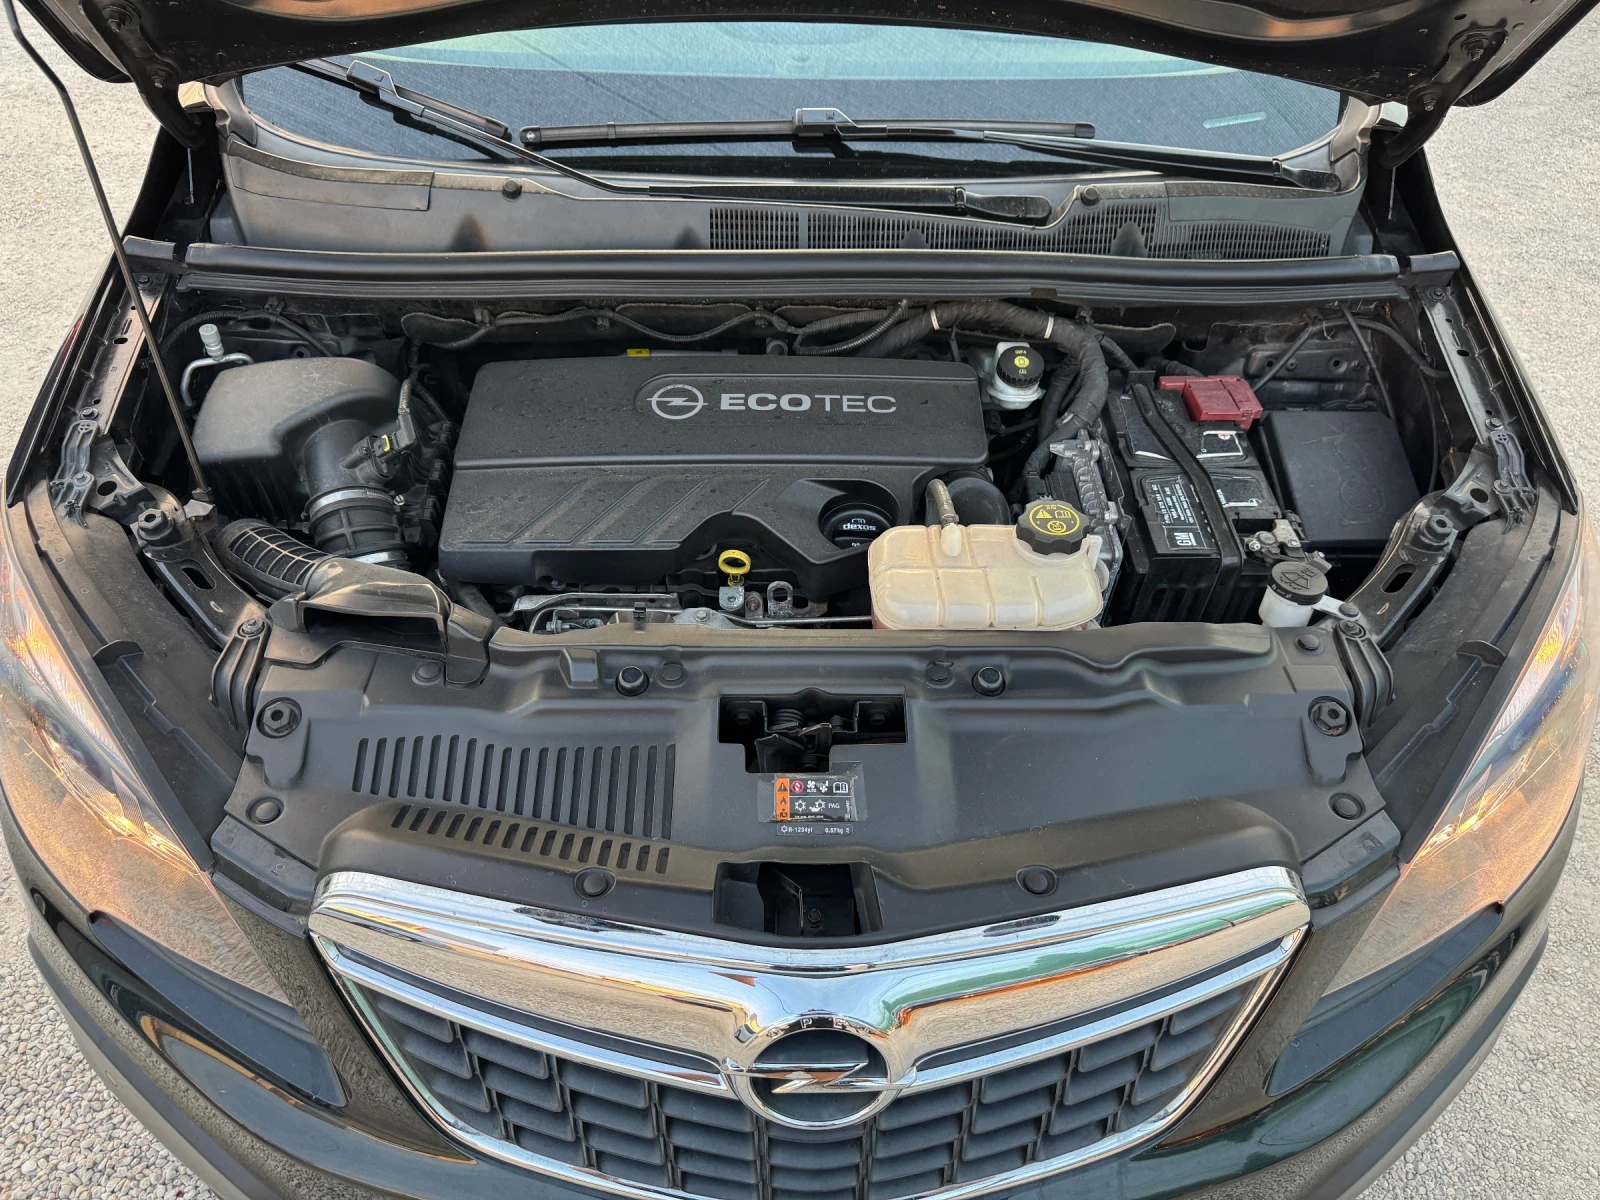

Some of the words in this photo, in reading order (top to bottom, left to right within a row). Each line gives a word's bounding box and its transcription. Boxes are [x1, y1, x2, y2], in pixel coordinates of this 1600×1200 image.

[720, 393, 897, 413] ECOTEC
[842, 522, 876, 530] dexos
[1174, 532, 1192, 546] GM
